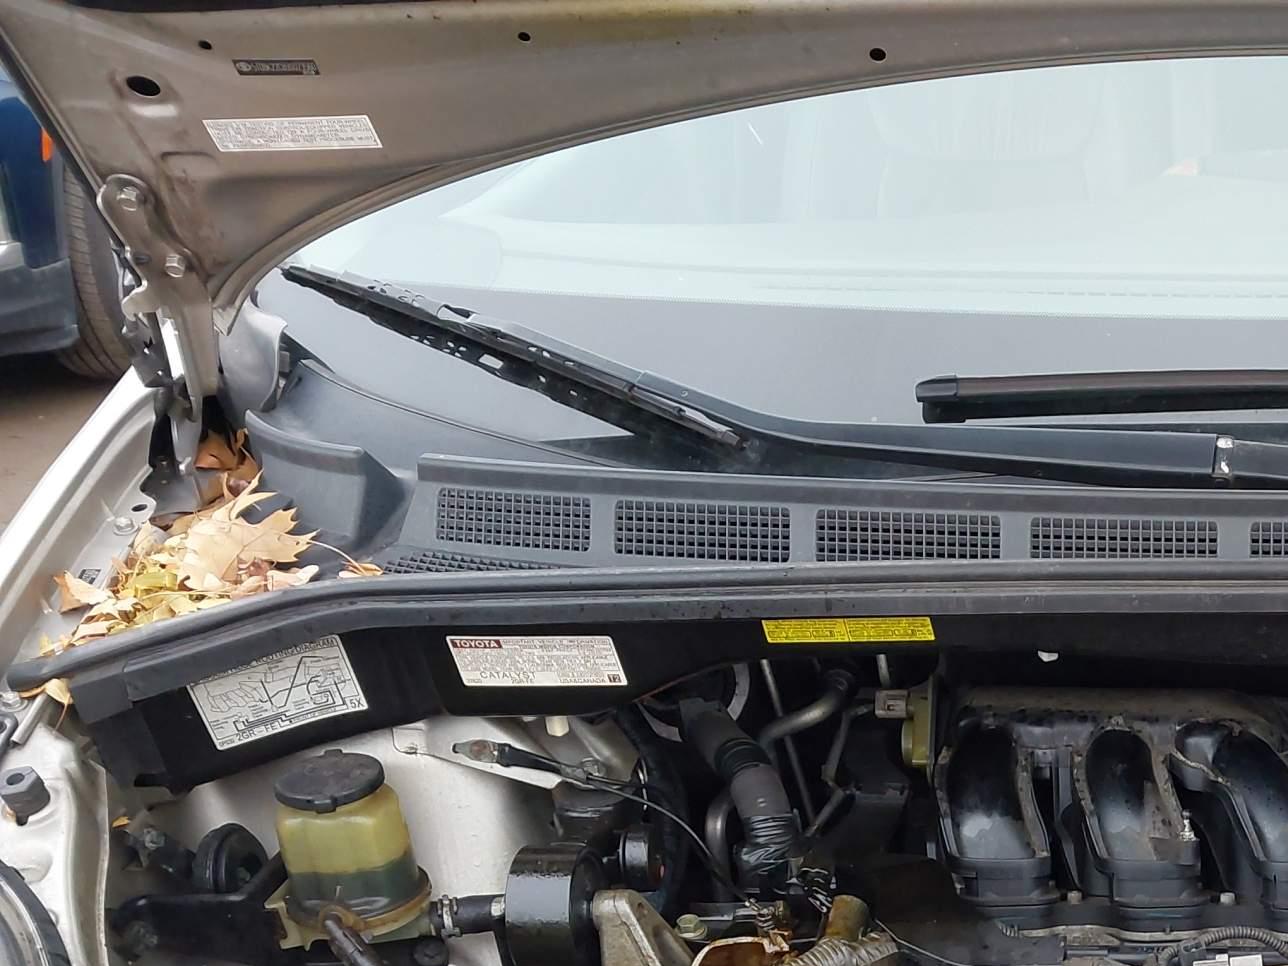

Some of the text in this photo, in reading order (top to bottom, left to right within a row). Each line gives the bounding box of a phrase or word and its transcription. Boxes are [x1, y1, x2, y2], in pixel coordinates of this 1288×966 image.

[454, 640, 499, 648] TOYOTA
[480, 671, 536, 679] CATALYST
[350, 697, 365, 709] 5X
